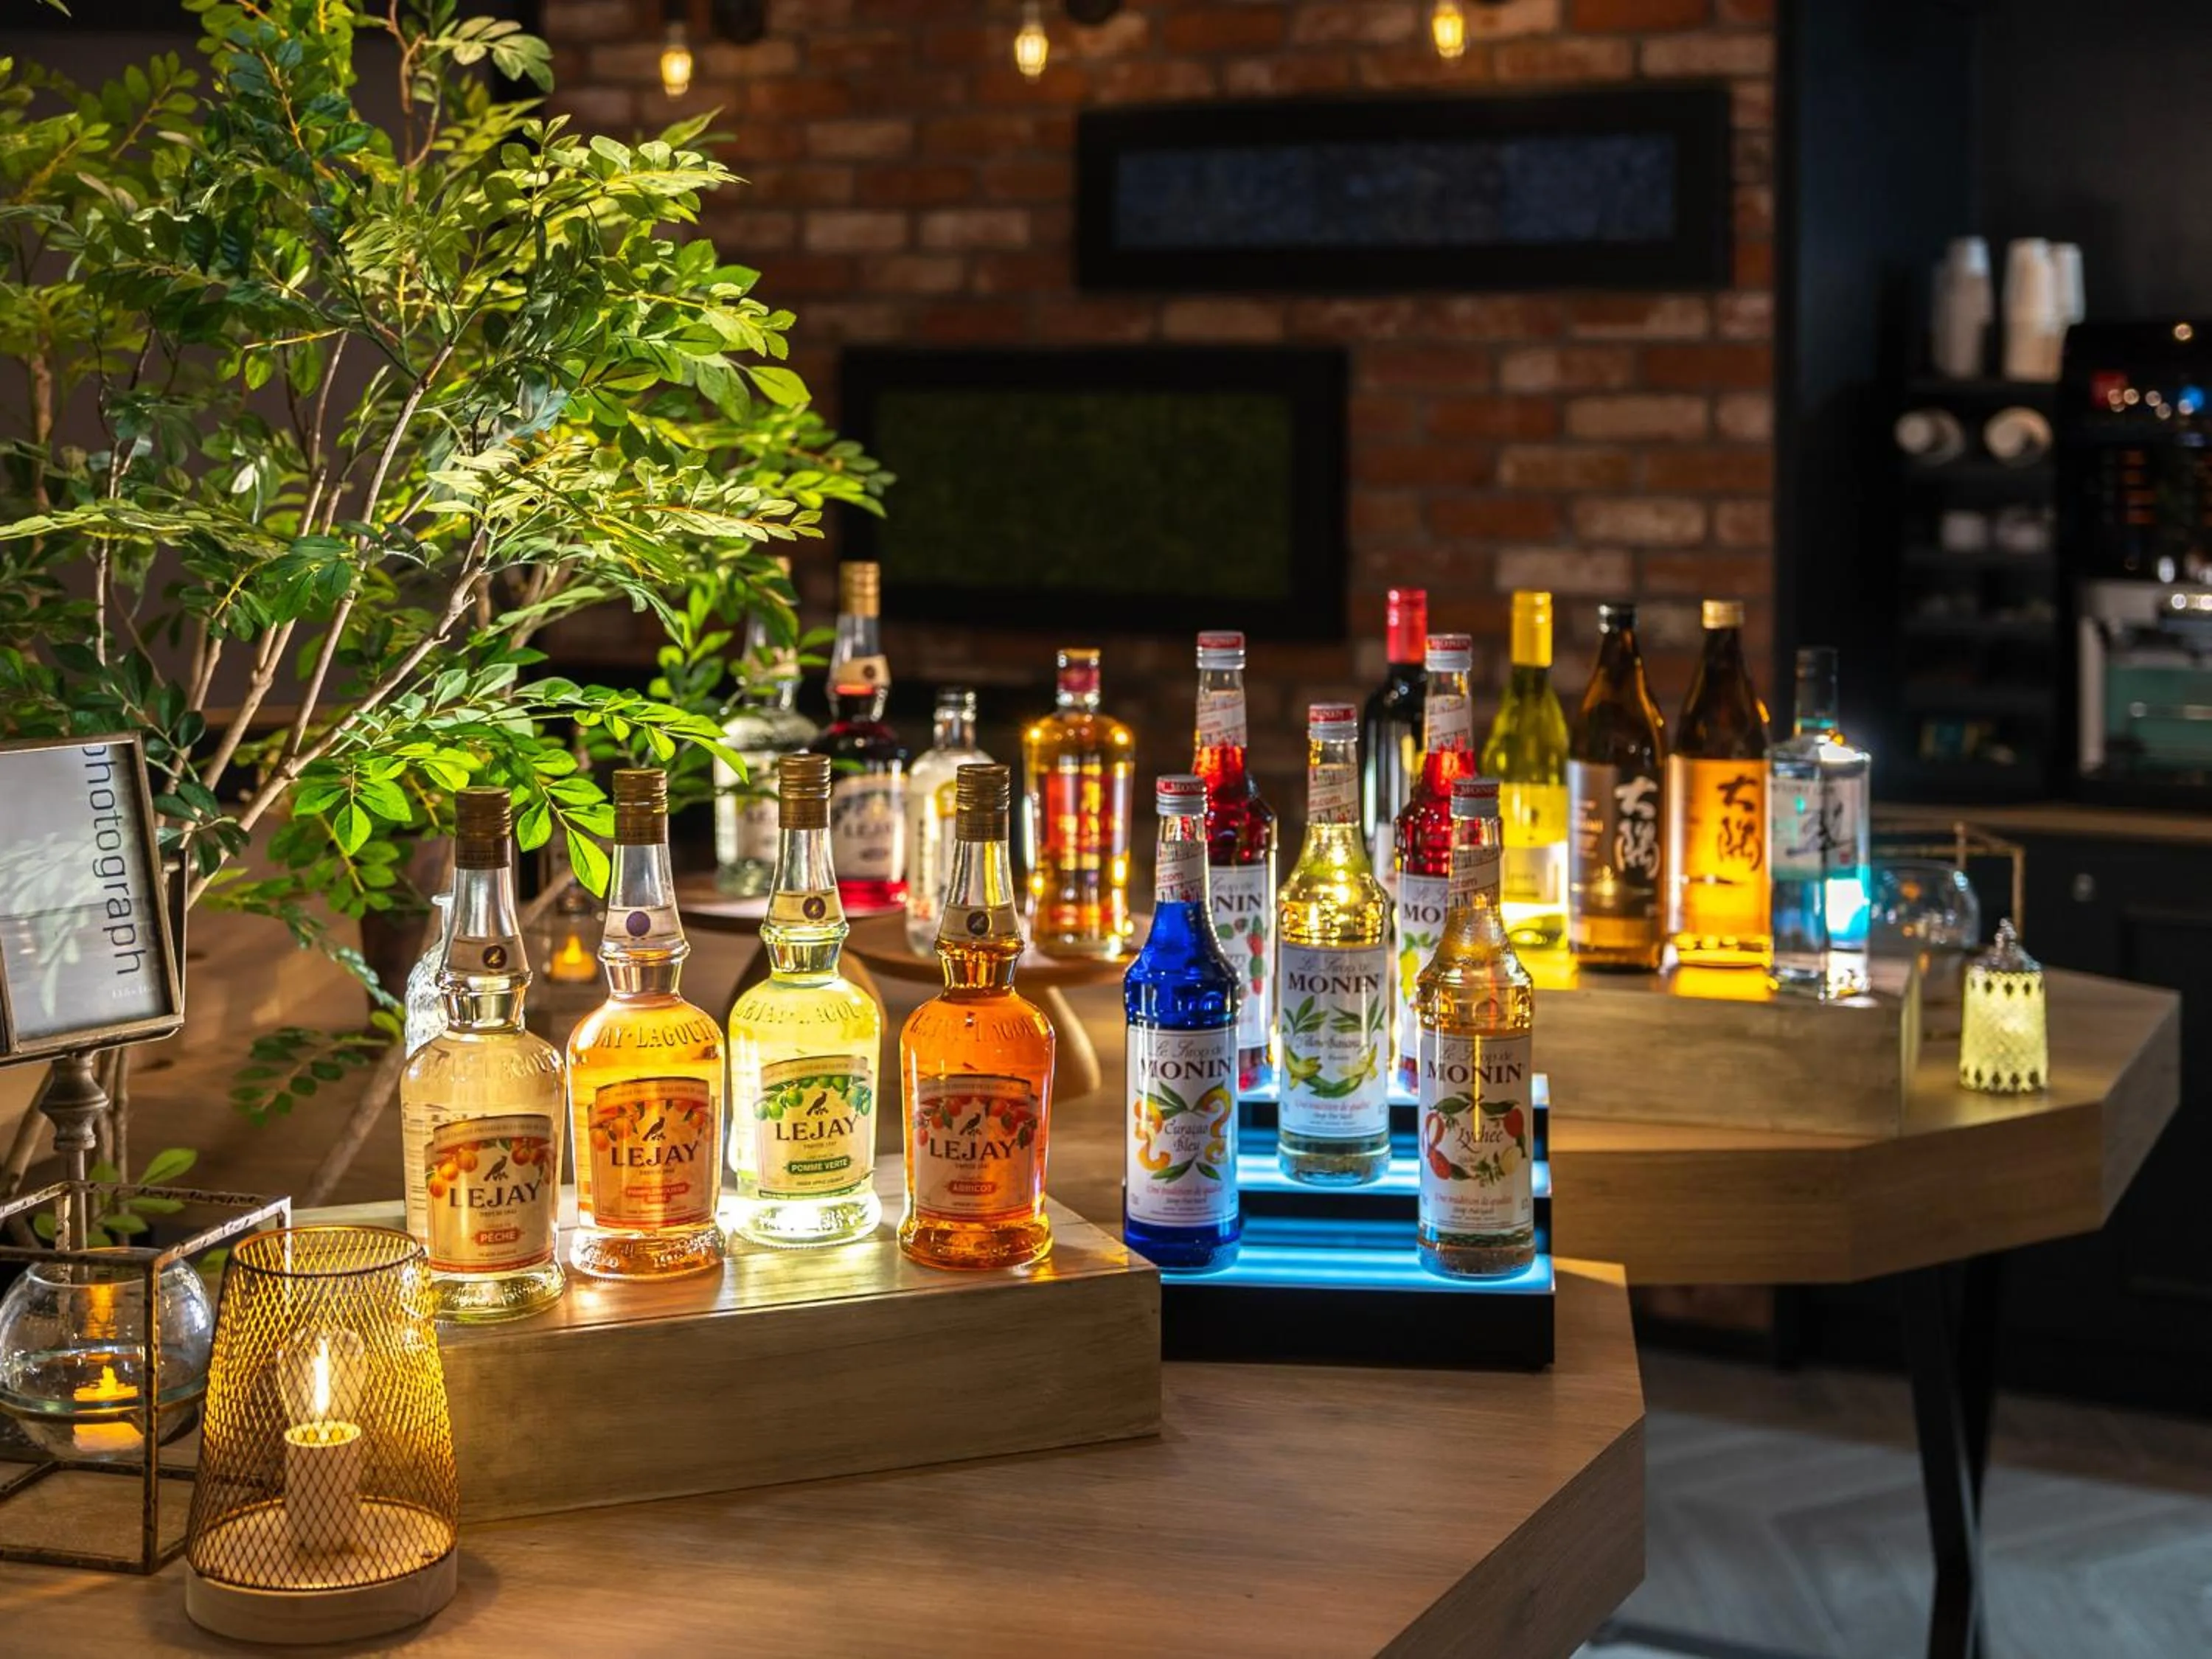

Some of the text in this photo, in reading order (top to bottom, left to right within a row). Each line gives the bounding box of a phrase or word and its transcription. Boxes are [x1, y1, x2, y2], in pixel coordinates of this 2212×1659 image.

[1211, 892, 1263, 913] NIN
[1288, 972, 1380, 994] MONIN
[1141, 1057, 1231, 1080] MONIN
[1427, 1060, 1522, 1084] MONIN
[776, 1116, 858, 1141] LEJAY
[611, 1141, 699, 1167] LEJAY
[930, 1138, 1016, 1161] LEJAY
[824, 1158, 848, 1169] VERTE
[449, 1181, 543, 1208] LEJAY
